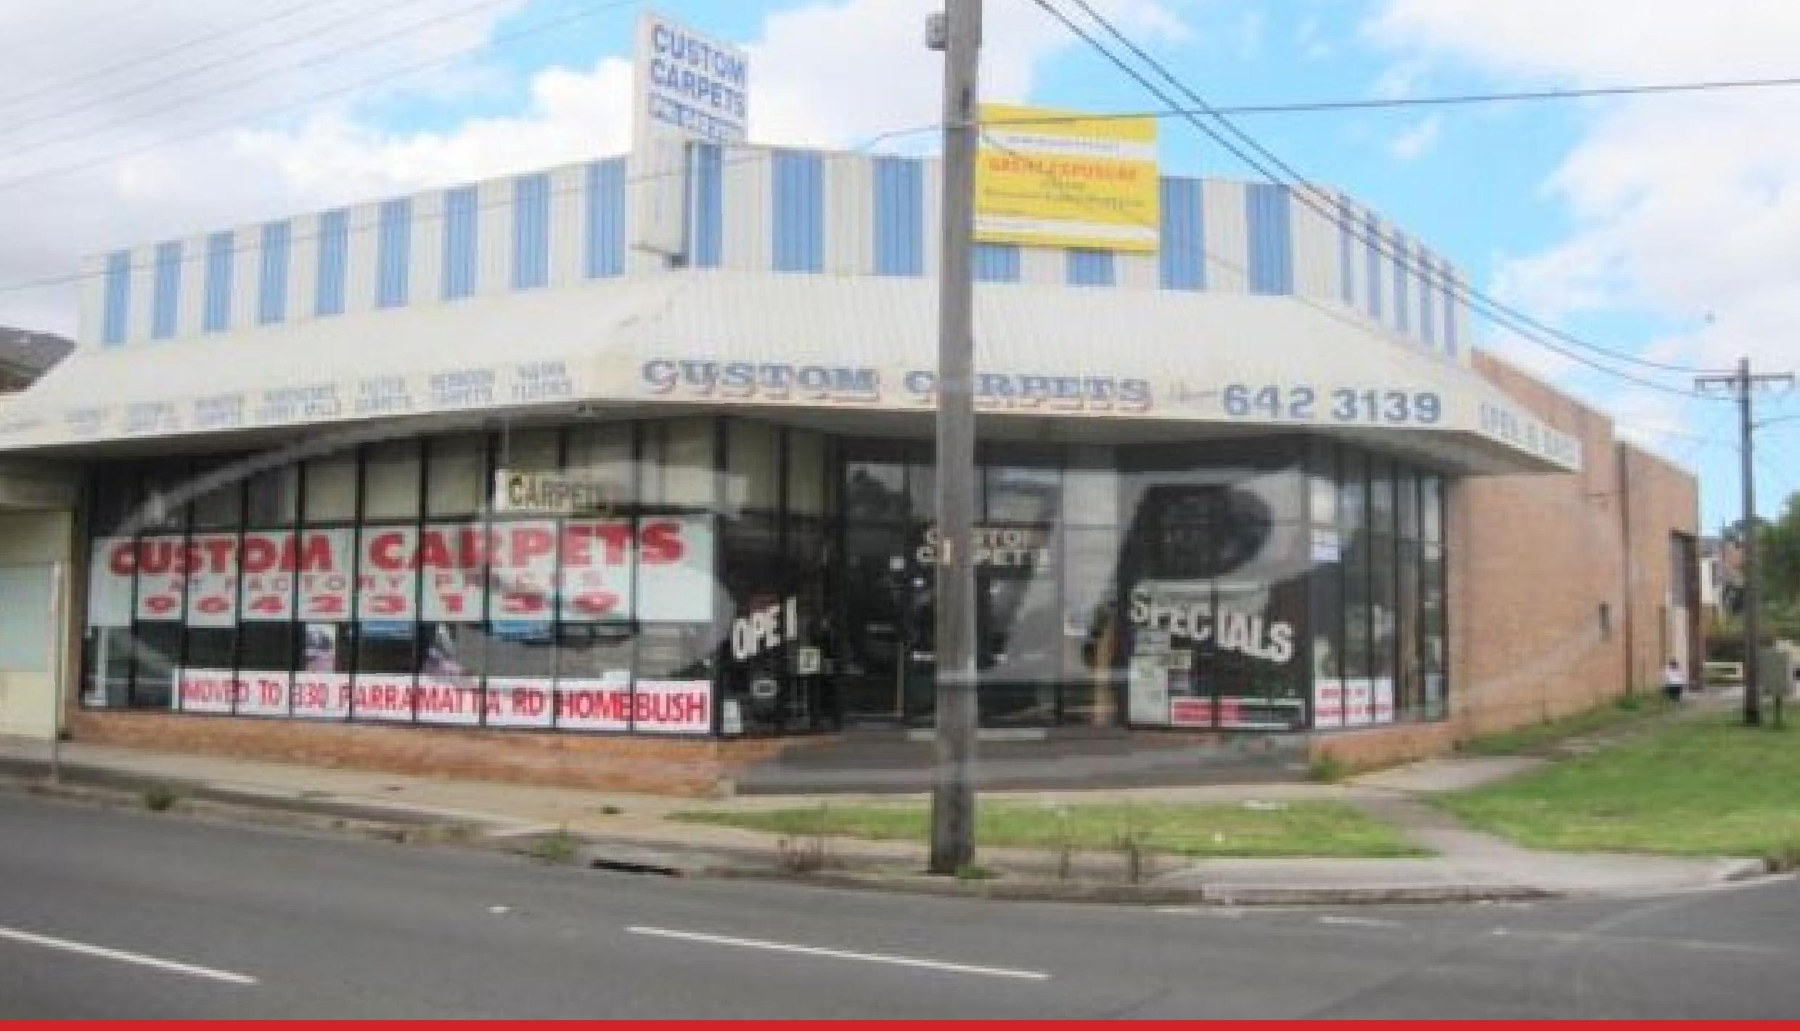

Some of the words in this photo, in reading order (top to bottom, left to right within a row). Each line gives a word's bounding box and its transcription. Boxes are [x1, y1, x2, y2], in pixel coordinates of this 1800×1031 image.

[651, 24, 745, 90] CUSTOM
[650, 58, 745, 117] CARPETS
[642, 359, 880, 401] CUSTOM
[902, 370, 1153, 411] CRPETS
[1223, 383, 1315, 418] 642
[1331, 387, 1442, 424] 3139
[107, 534, 333, 577] CUSTOM
[367, 521, 687, 570] CARPETS
[1131, 586, 1293, 664] SPECIALS
[179, 680, 249, 704] MOVED
[259, 679, 282, 706] TO
[338, 683, 500, 713] PARRAMATTA
[511, 687, 543, 716] RD
[553, 688, 705, 722] HOMEBUSH
